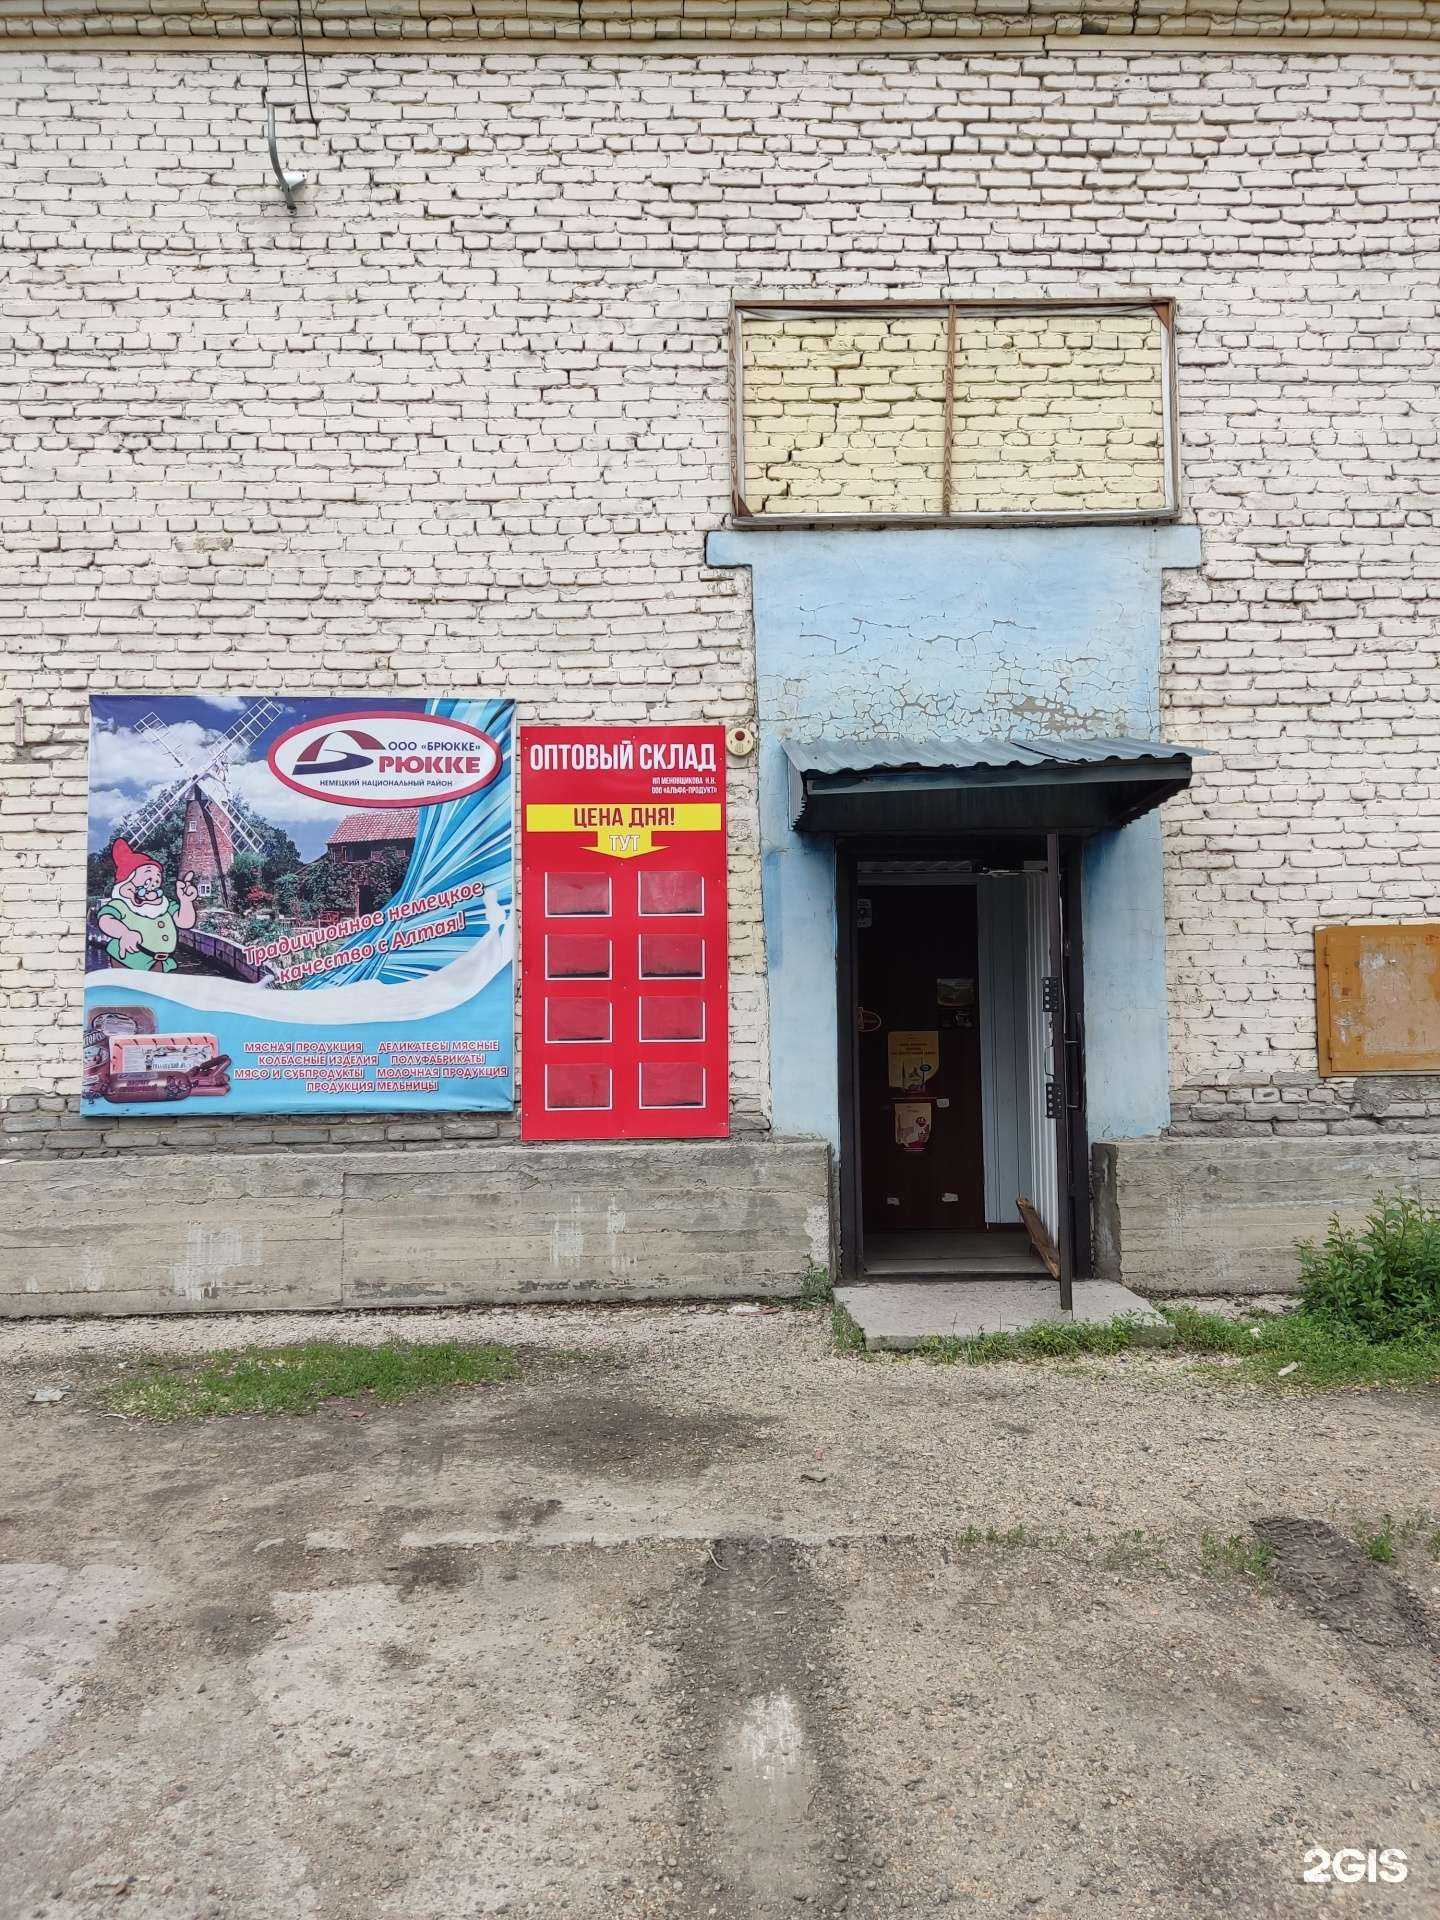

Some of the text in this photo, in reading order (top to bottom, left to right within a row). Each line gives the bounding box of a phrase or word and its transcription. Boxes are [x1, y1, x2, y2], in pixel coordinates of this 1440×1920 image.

[388, 741, 481, 752] ООО «БРЮККЕ»
[530, 740, 717, 772] ОПТОВЫЙ СКЛАД
[319, 778, 453, 788] НЕМЕЦКИЙ НАЦИОНАЛЬНЫЙ РАЙОН
[651, 786, 663, 794] ООО
[573, 807, 675, 828] ЦЕНА ДНЯ!
[608, 834, 641, 852] ТУТ
[243, 882, 484, 966] Традиционное немецкое
[279, 911, 466, 983] качество с Алтая!
[244, 1042, 363, 1053] МЯСНАЯ ПРОДУКЦИЯ
[378, 1040, 500, 1053] ДЕЛИКАТЕСЫ МЯСНЫЕ
[258, 1055, 379, 1067] КОЛБАСНЫЕ ИЗДЕЛИЯ
[390, 1054, 486, 1066] ПОЛУФАБРИКАТЫ
[234, 1068, 364, 1080] МЯСО И СУБПРОДУКТЫ
[376, 1067, 508, 1079] МОЛОЧНАЯ ПРОДУКЦИЯ
[306, 1081, 439, 1094] ПРОДУКЦИЯ МЕЛЬНИЦЫ
